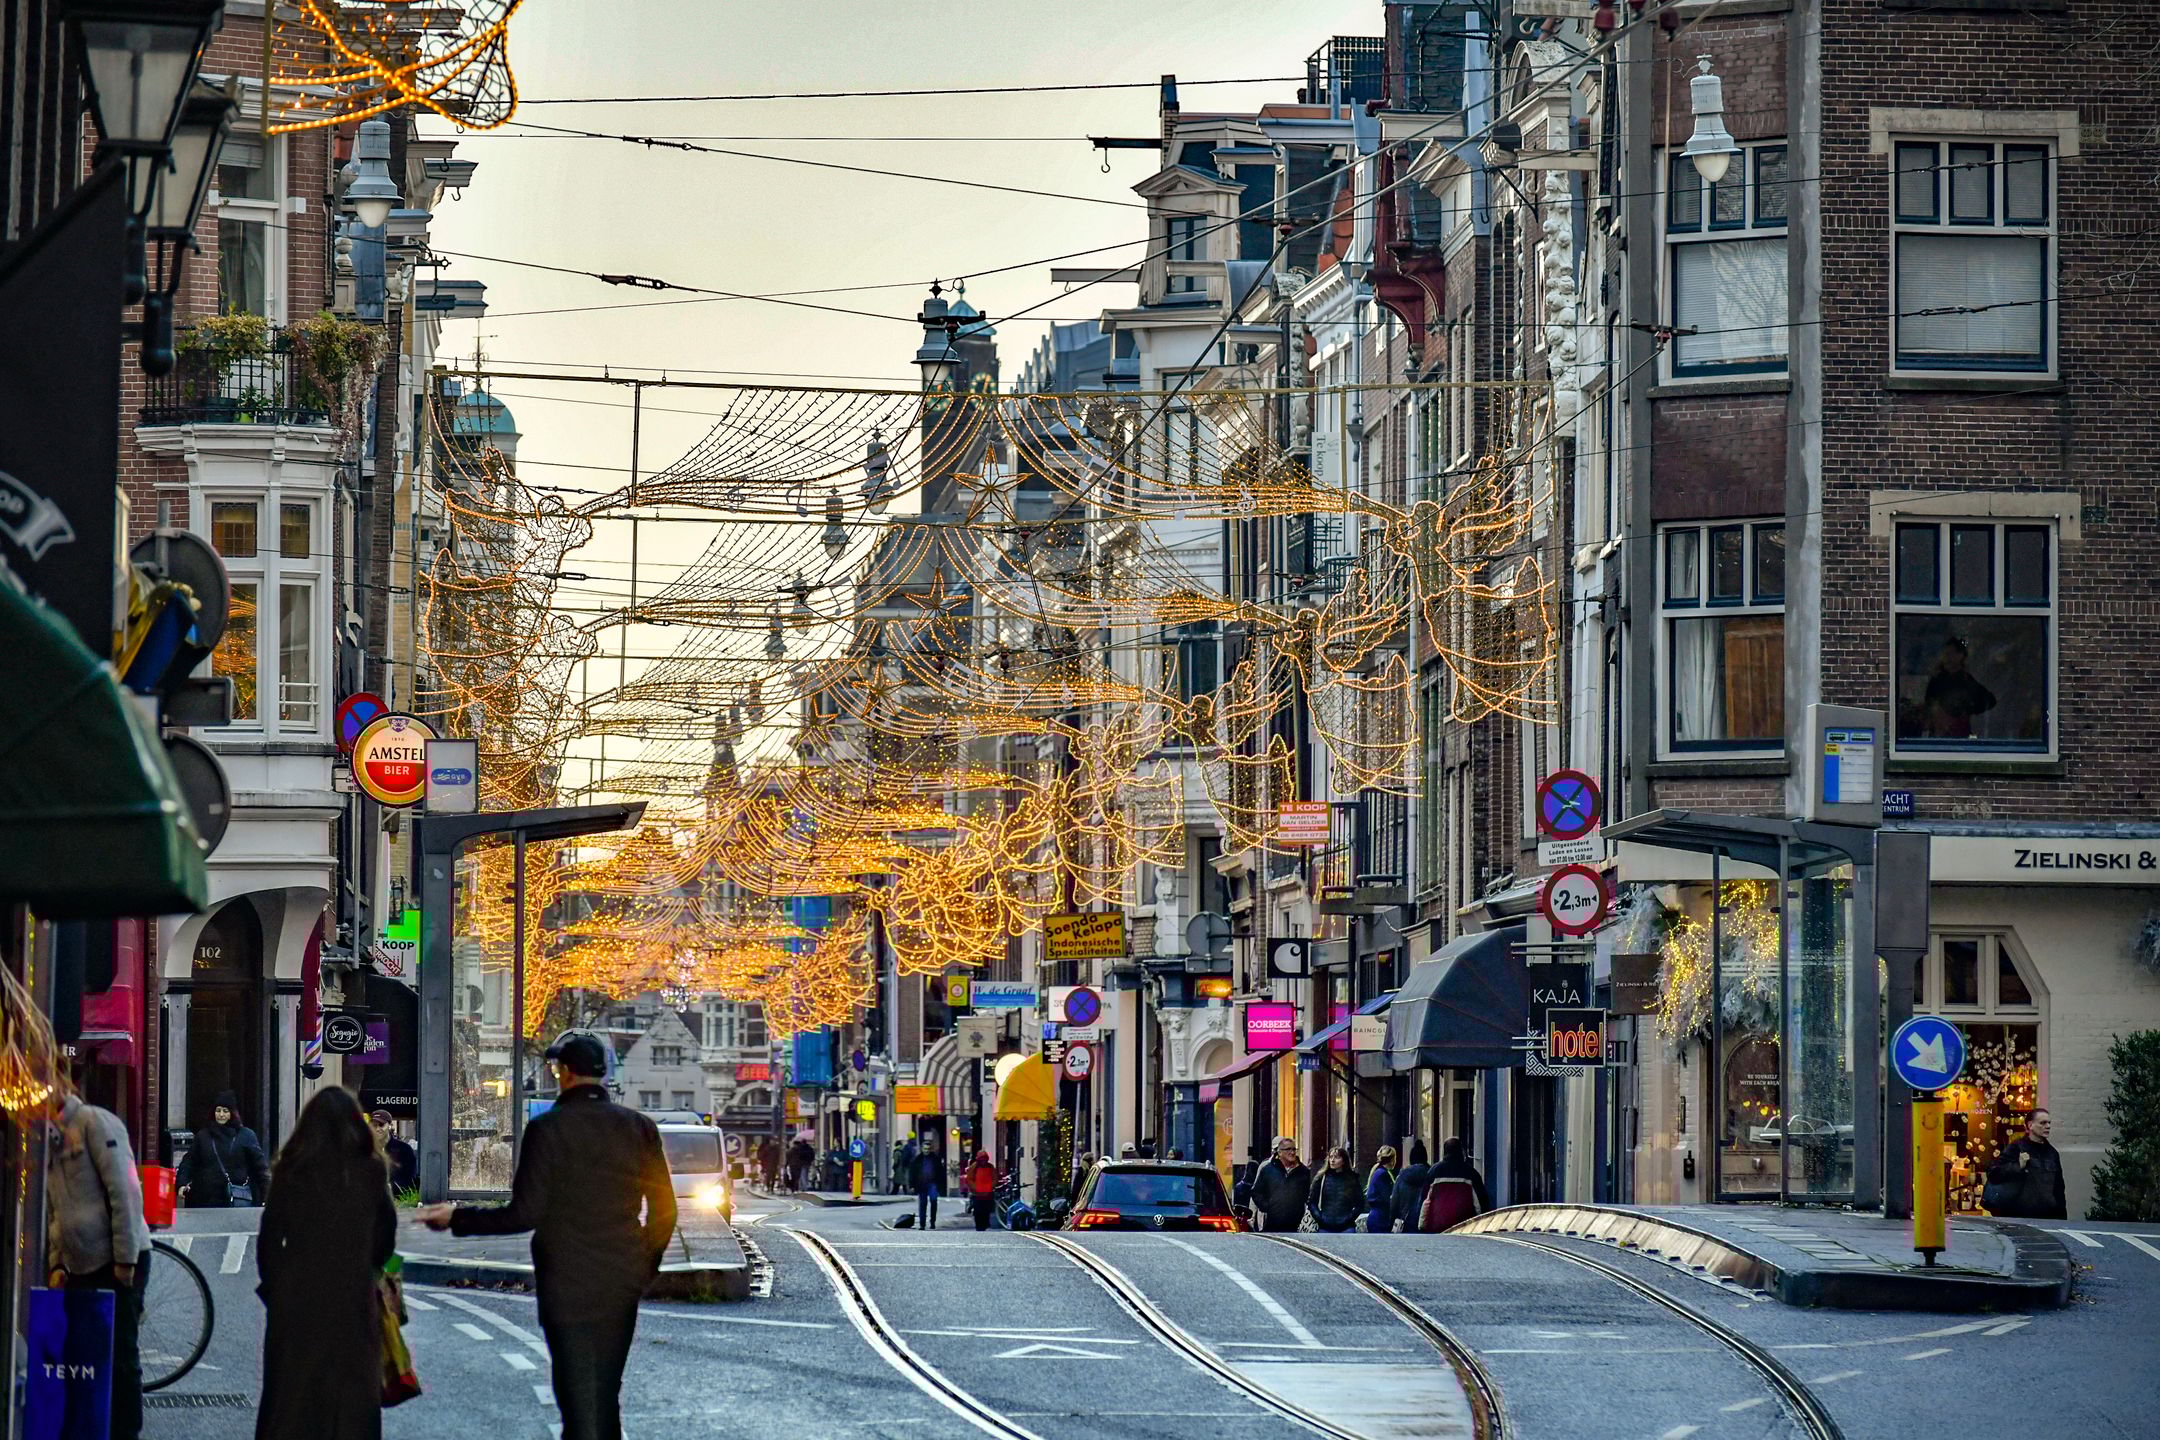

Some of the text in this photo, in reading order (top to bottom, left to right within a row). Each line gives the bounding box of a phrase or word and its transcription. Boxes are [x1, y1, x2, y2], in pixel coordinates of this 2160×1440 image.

[1314, 435, 1326, 477] Te koop
[384, 765, 410, 775] BIER
[1281, 803, 1327, 812] TE KOOP
[1551, 840, 1589, 849] Uitgezonderd
[2138, 851, 2157, 870] &
[1558, 889, 1591, 911] 2,3m
[1045, 914, 1098, 938] Soenda
[1073, 918, 1122, 940] Kelapa
[382, 941, 415, 950] KOOP
[1050, 938, 1120, 948] Indonesische
[200, 946, 221, 958] 102
[1049, 947, 1121, 958] Specialiteiten
[375, 950, 401, 977] RKOCHT
[989, 985, 1000, 995] de
[1003, 985, 1033, 997] Graaf
[1533, 988, 1581, 1003] KAJA
[1248, 1020, 1291, 1028] OORBEEK
[1550, 1022, 1603, 1058] hotel
[376, 1096, 411, 1104] SLAGERIJ
[42, 1363, 95, 1380] TEYM
